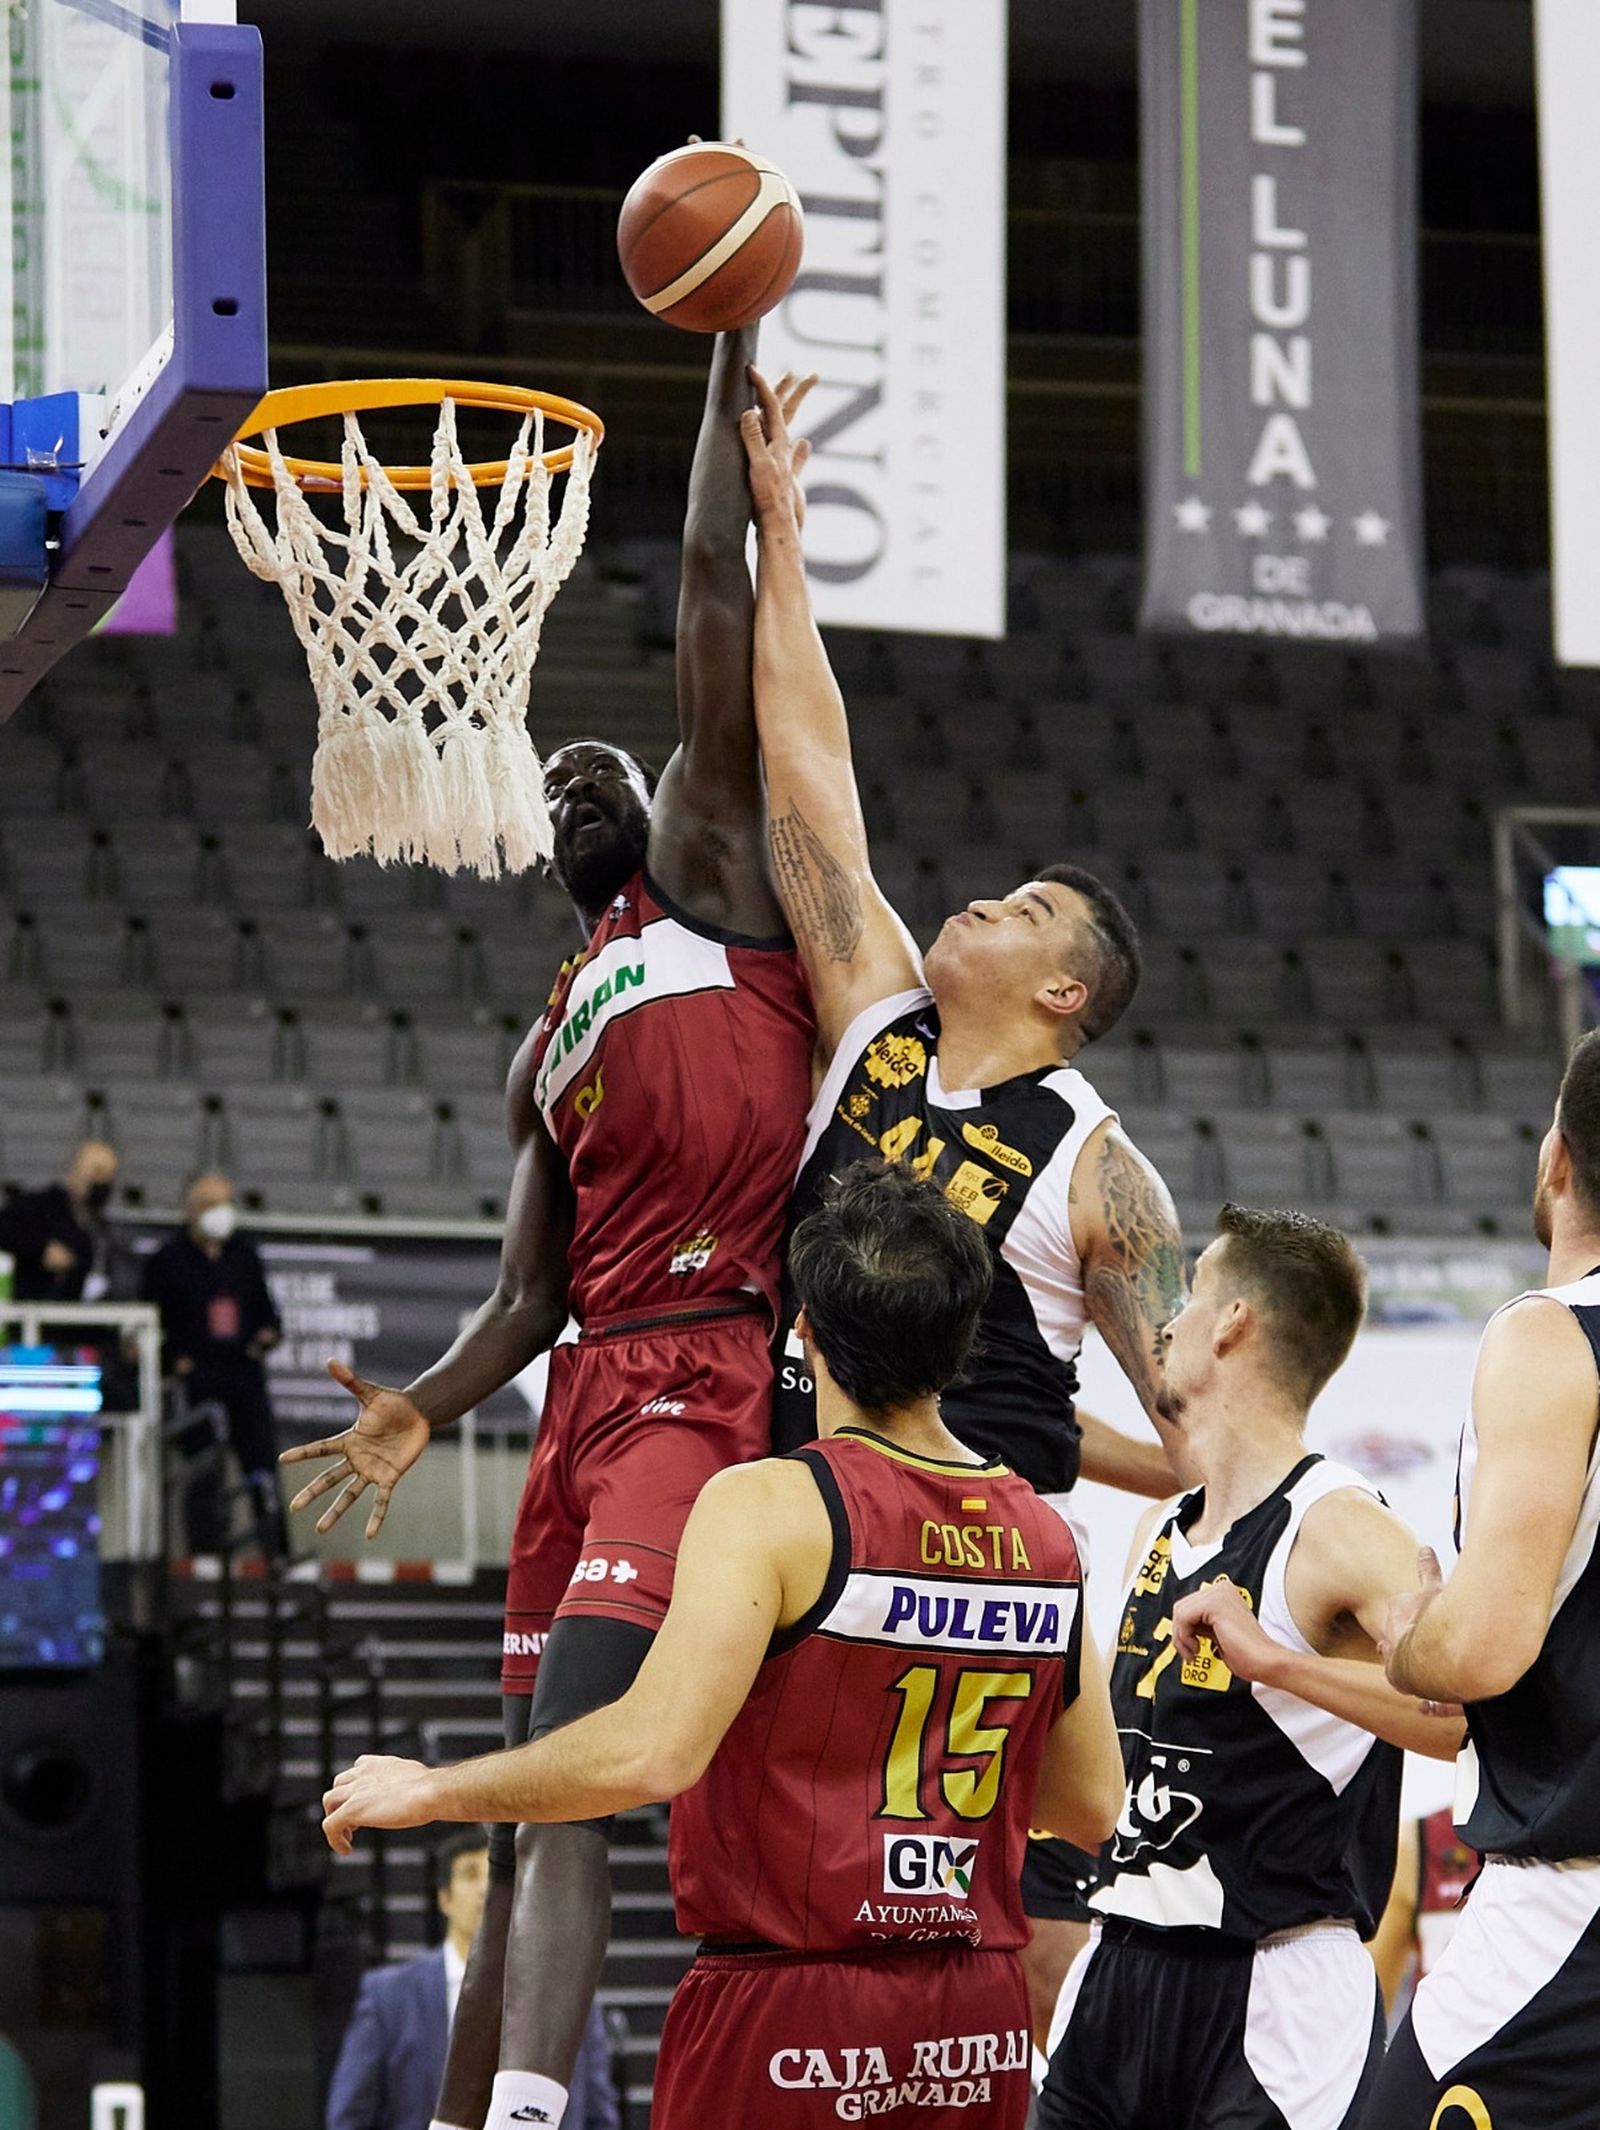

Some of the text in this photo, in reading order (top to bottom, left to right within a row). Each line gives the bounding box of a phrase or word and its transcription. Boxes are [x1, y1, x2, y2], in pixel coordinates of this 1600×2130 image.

[784, 0, 887, 584] EPTUNO
[1247, 174, 1317, 490] LUNA
[1252, 554, 1311, 596] DE
[1187, 591, 1380, 645] GRANADA
[949, 1181, 979, 1201] LEB
[920, 1519, 1032, 1571] COSTA
[881, 1585, 1060, 1644] PULEVA
[1184, 1668, 1208, 1683] ORO
[873, 1663, 1033, 1823] 15
[769, 2047, 892, 2090] CAJA
[836, 2078, 991, 2121] GRANADA
